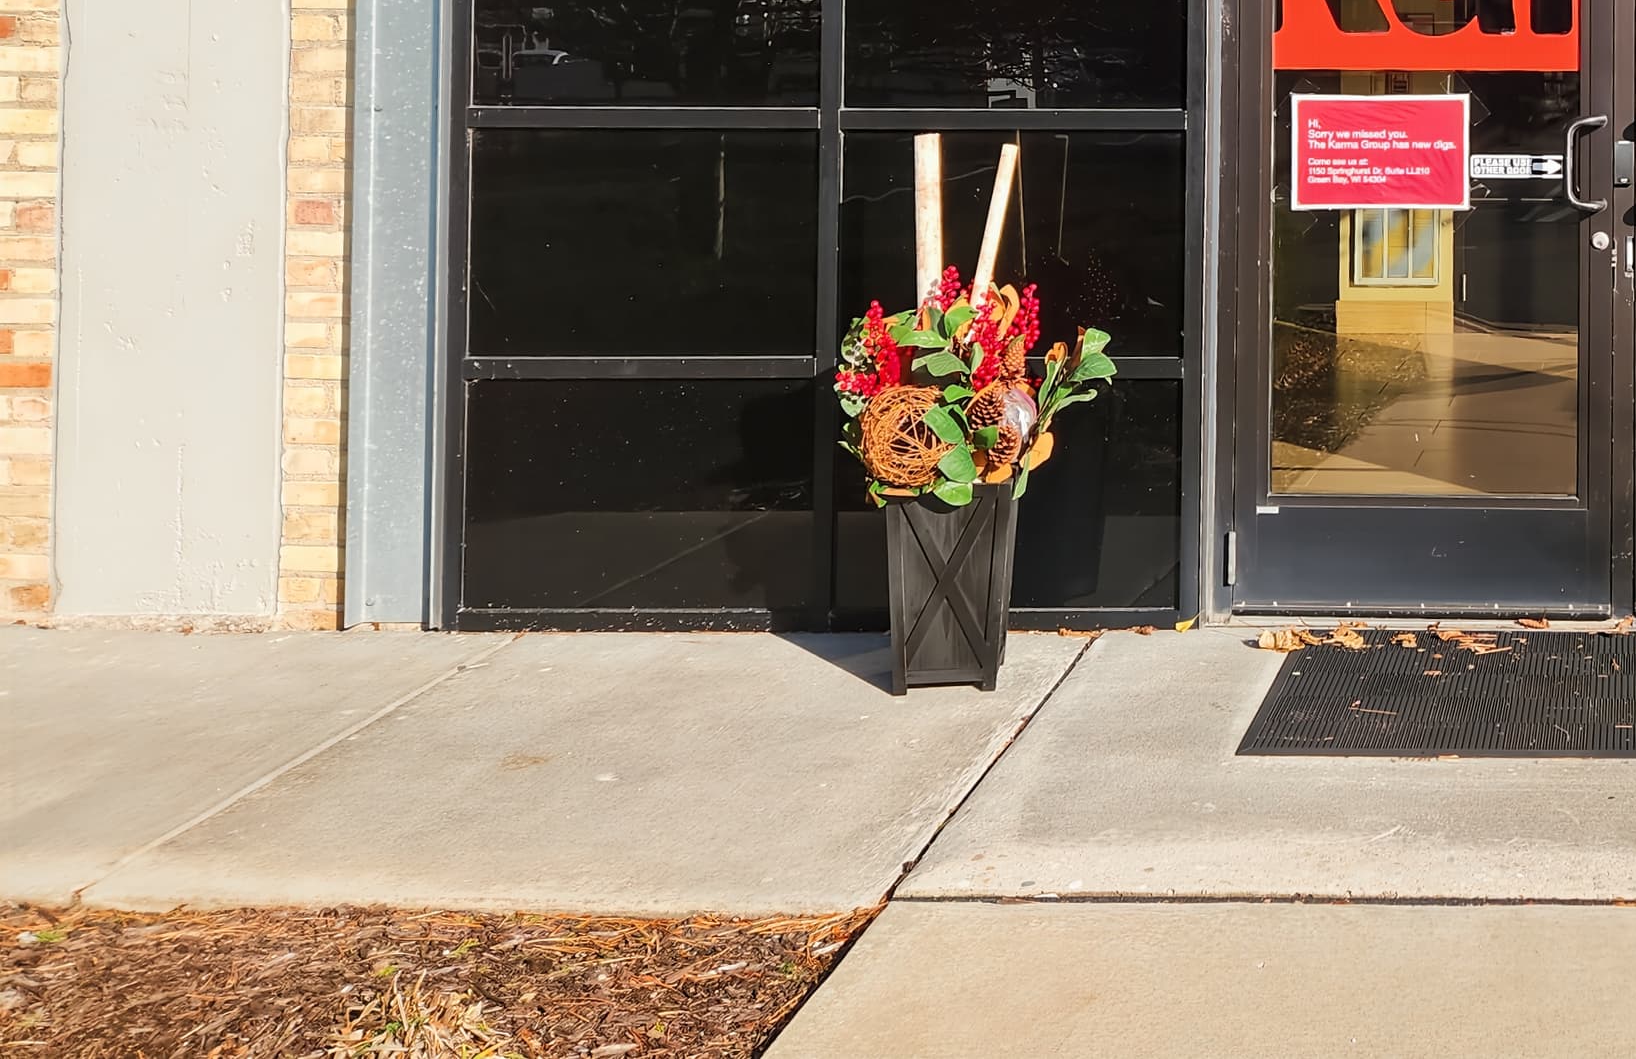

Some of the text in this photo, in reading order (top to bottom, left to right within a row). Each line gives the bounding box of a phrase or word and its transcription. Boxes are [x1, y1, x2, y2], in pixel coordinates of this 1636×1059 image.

[1307, 129, 1408, 141] Sorry we missed you.
[1307, 140, 1326, 149] The
[1328, 140, 1359, 149] Karma
[1360, 140, 1391, 151] Group
[1392, 140, 1410, 149] has
[1411, 141, 1432, 149] new
[1307, 157, 1331, 165] Come
[1474, 157, 1512, 167] PLEASE
